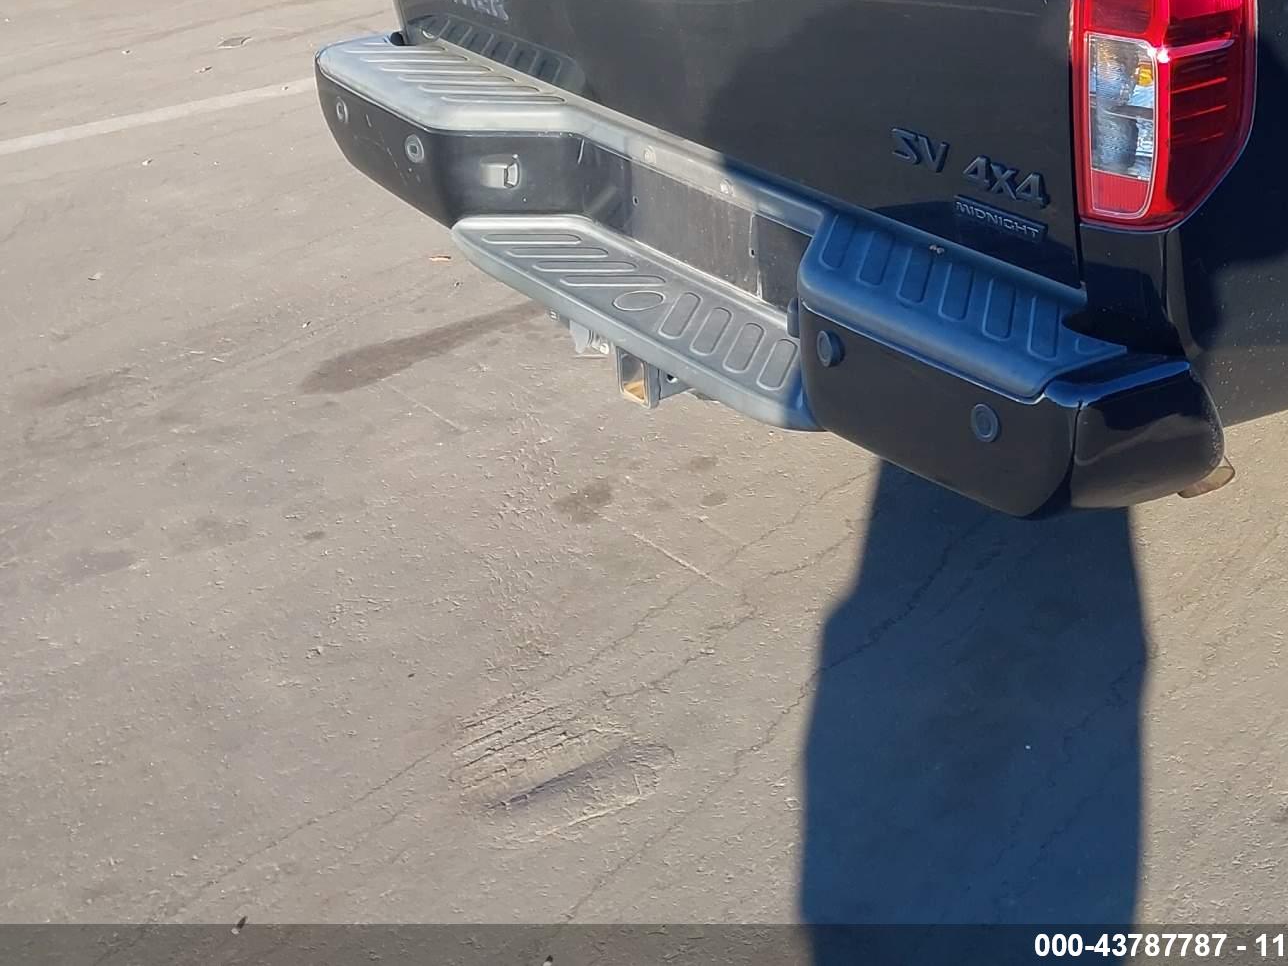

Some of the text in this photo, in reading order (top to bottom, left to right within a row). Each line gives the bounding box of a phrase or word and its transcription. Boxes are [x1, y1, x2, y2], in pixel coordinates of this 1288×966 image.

[891, 127, 1050, 209] SV 4X4
[955, 200, 1040, 238] MIDNIGHT
